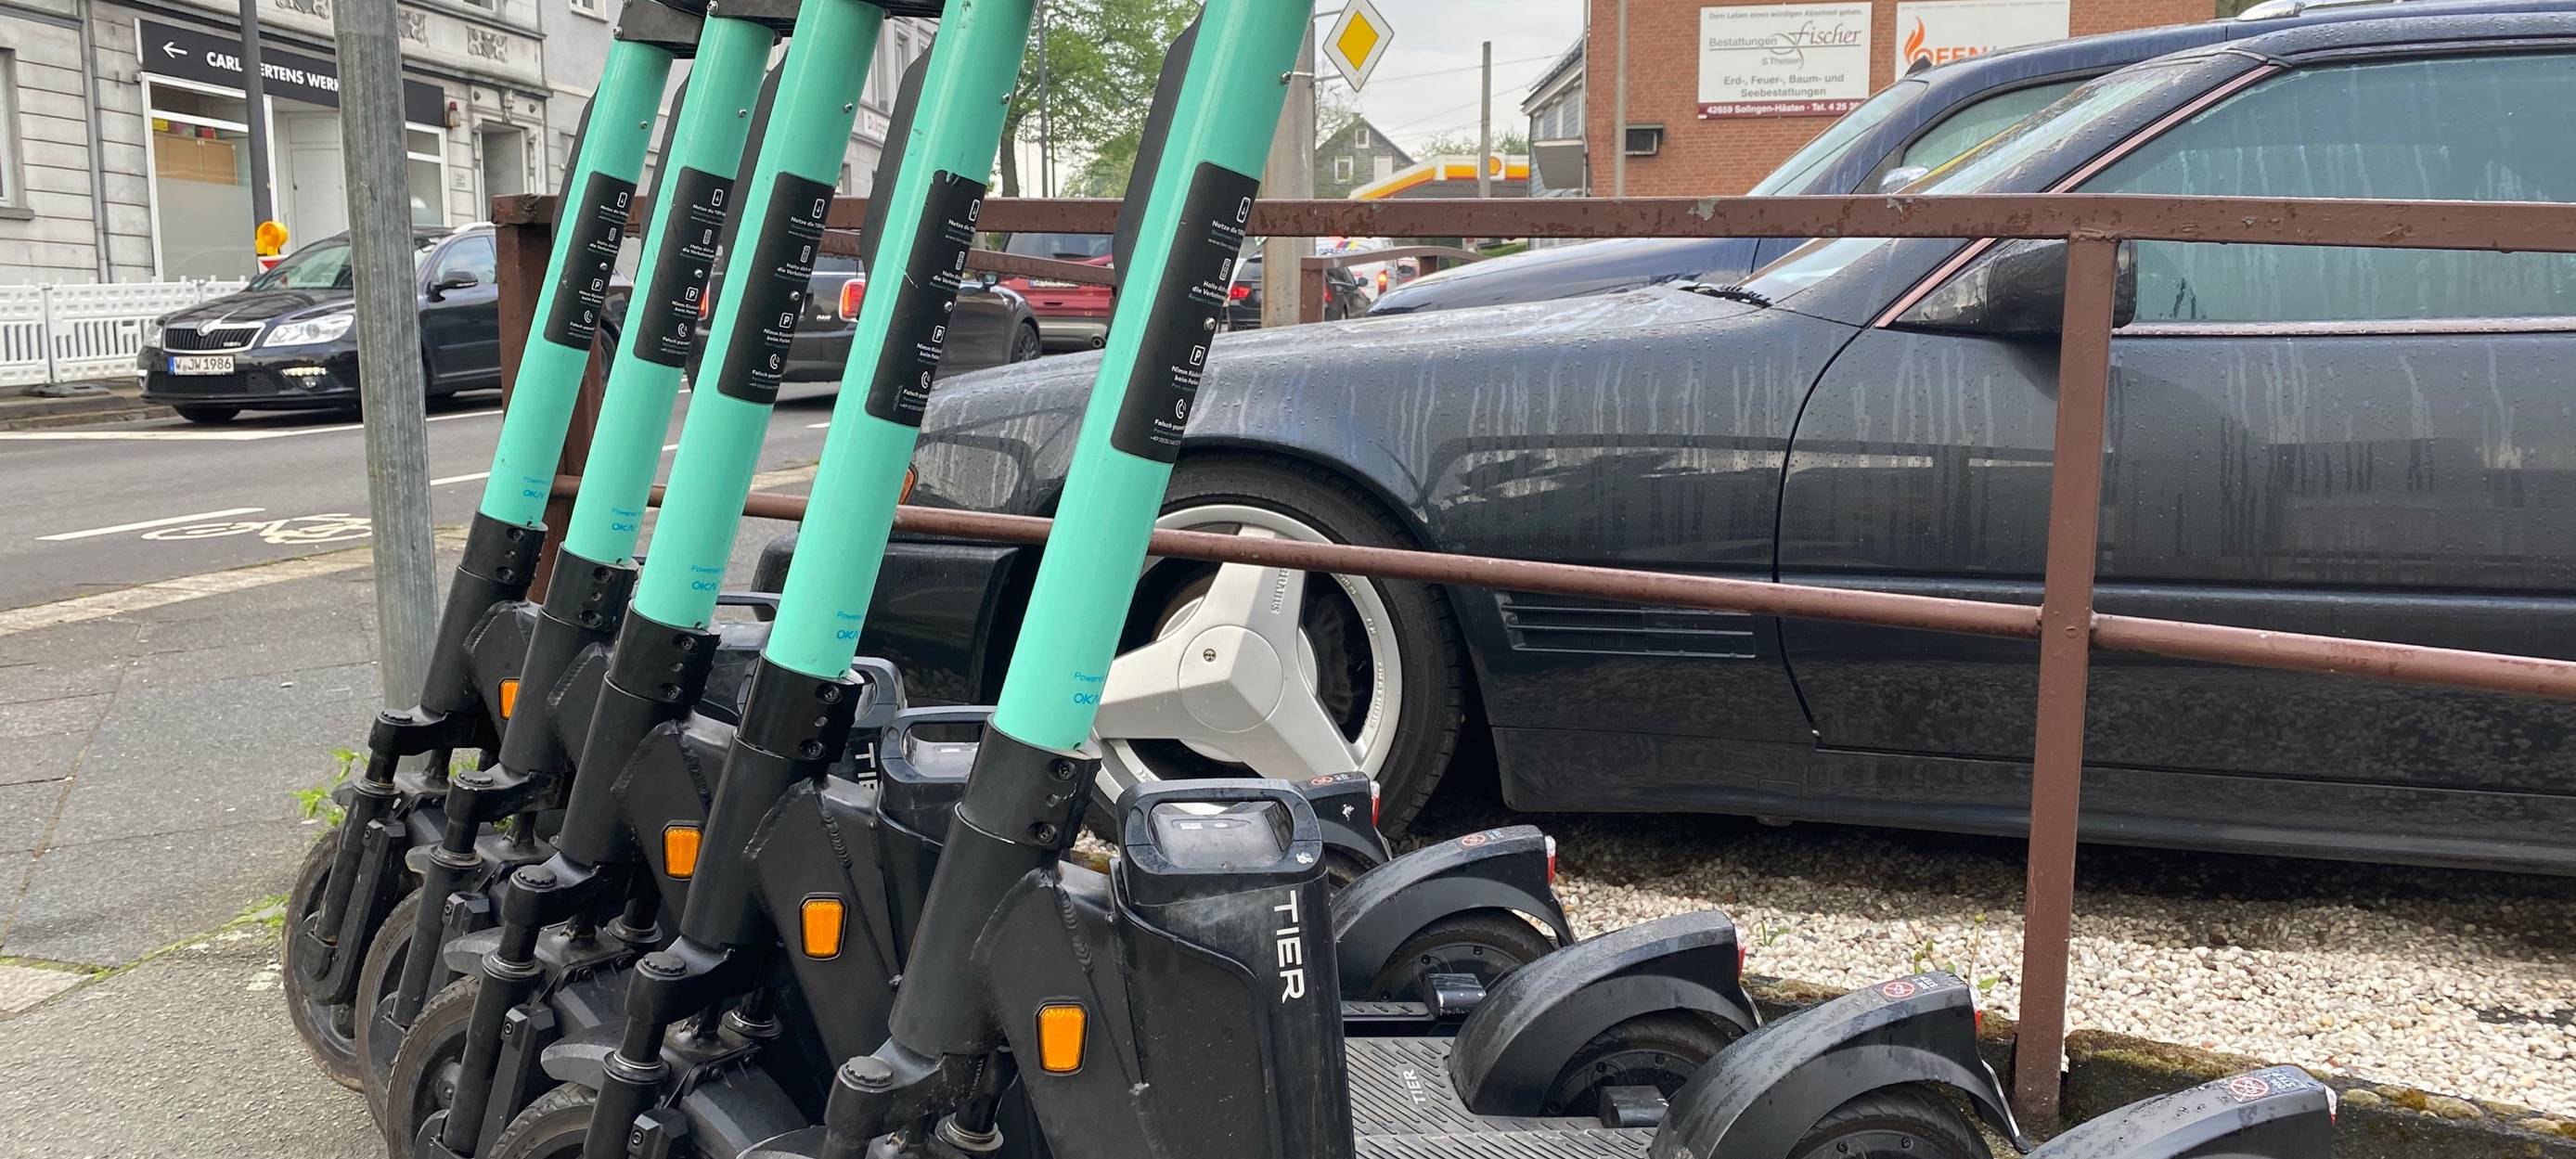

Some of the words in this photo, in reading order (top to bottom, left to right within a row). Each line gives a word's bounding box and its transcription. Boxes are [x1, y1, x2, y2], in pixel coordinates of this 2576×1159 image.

[1709, 37, 1778, 48] Bestattungen
[206, 52, 242, 72] CARL
[260, 62, 304, 85] ERTENS
[1751, 75, 1786, 85] Feuer-,
[1789, 74, 1823, 84] Baum-
[1824, 73, 1845, 84] und
[1741, 87, 1826, 98] Seebestattungen
[1811, 103, 1827, 111] Tel.
[203, 357, 231, 370] 1986
[1274, 890, 1306, 1005] TIER
[1402, 1068, 1426, 1105] TIER
